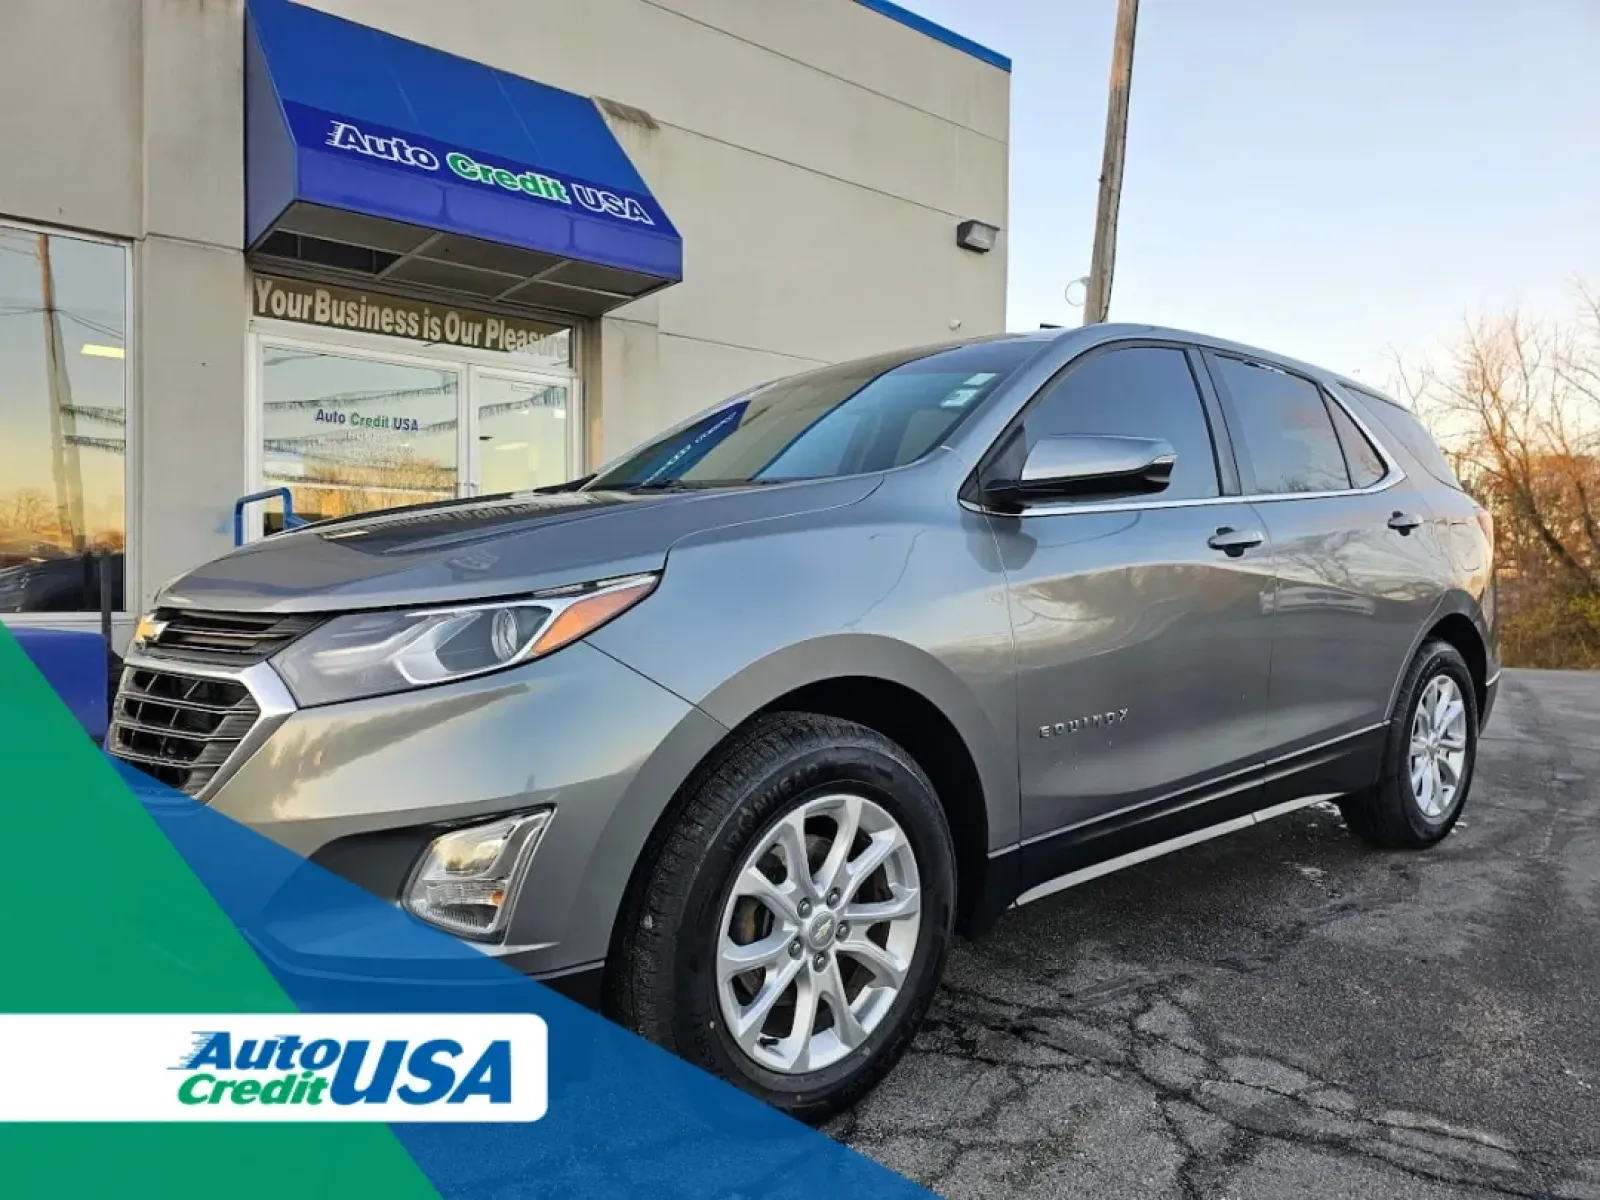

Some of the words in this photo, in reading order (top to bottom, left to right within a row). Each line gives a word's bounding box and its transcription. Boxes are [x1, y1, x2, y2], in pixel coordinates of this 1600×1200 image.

[326, 120, 439, 170] Auto
[446, 153, 572, 204] Credit
[572, 184, 654, 225] USA
[254, 279, 314, 321] Your
[314, 287, 420, 338] Business
[423, 307, 441, 342] is
[444, 310, 484, 347] Our
[315, 409, 346, 424] Auto
[349, 412, 390, 429] Credit
[393, 417, 419, 432] USA
[1038, 707, 1129, 739] EQUINOX
